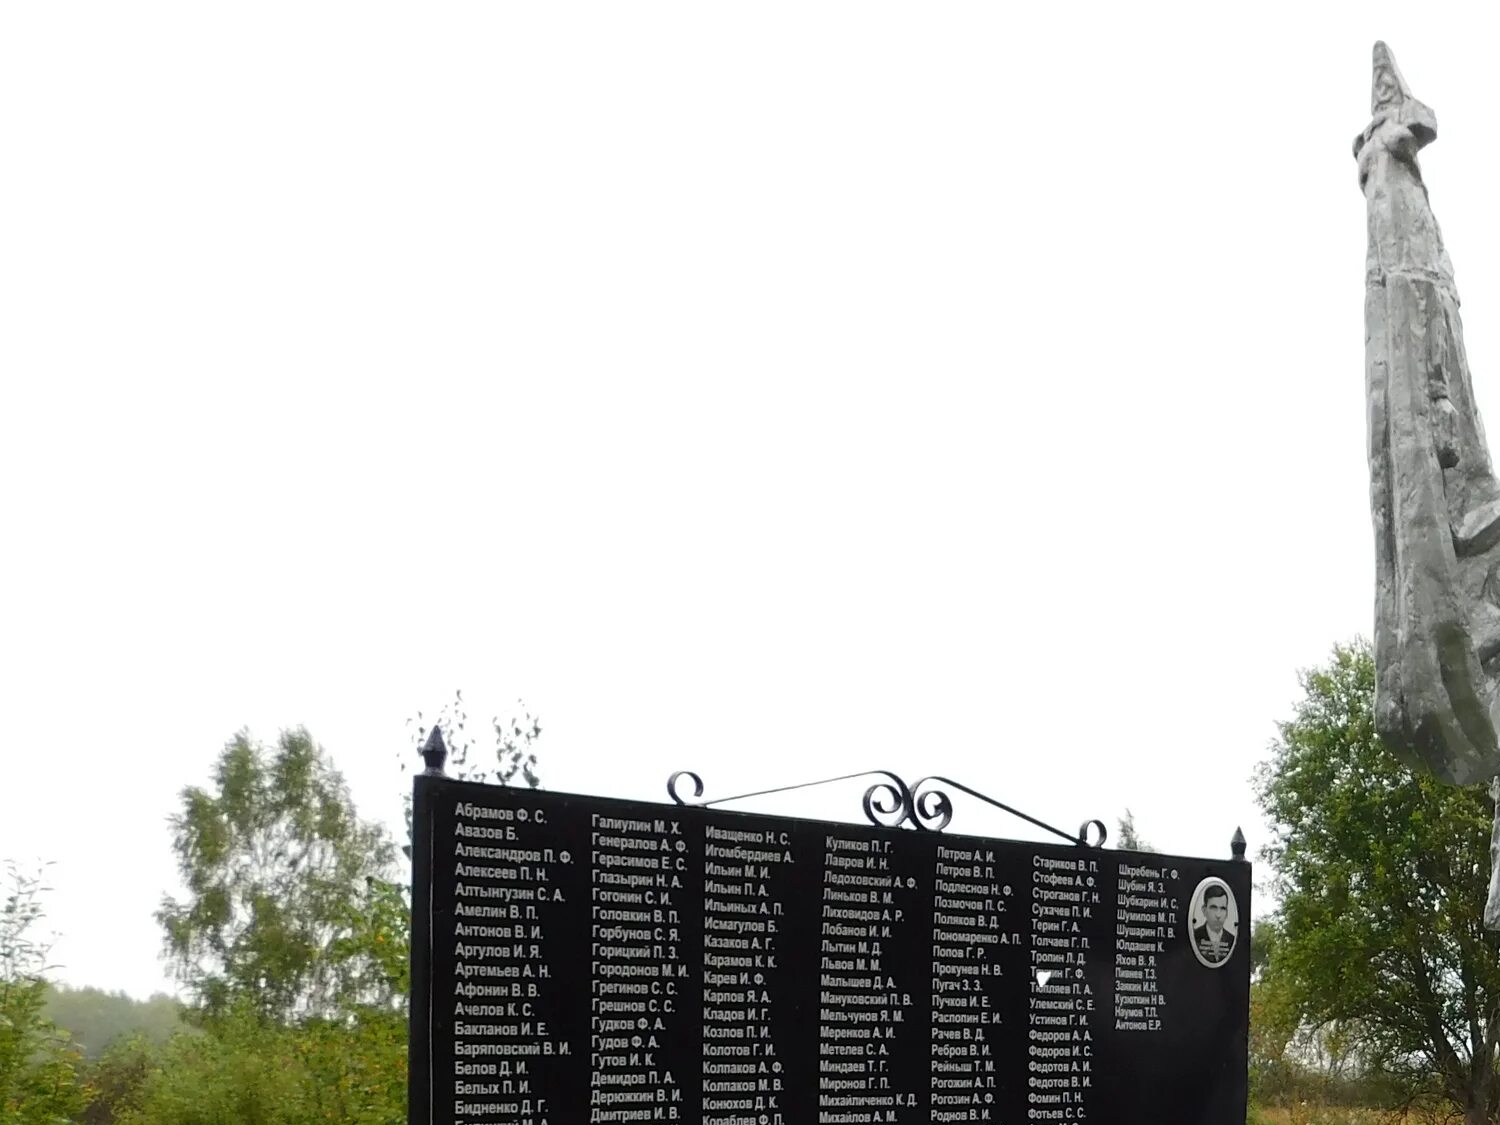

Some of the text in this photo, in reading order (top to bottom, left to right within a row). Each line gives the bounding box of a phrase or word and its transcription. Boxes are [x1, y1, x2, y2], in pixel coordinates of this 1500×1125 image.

[454, 802, 547, 823] Абрамов Ф. С.
[454, 822, 518, 840] Авазов Б.
[591, 813, 681, 834] Галиулин М. Х.
[592, 832, 657, 851] Генералов
[705, 825, 763, 843] Иващенко
[825, 835, 869, 851] Куликов
[454, 842, 573, 864] Александров П. Ф.
[592, 850, 658, 868] Герасимов
[937, 846, 972, 862] Петров
[705, 861, 741, 876] Ильин
[824, 853, 864, 869] Лавров
[1032, 855, 1076, 870] Стариков
[454, 862, 549, 881] Алексеев П. Н.
[936, 862, 971, 878] Петров
[592, 869, 653, 888] Глазырин
[823, 870, 891, 887] Ледоховский
[1118, 878, 1146, 893] Шубин
[454, 882, 534, 902] Алтынгузин
[704, 879, 741, 894] Ильин
[935, 879, 989, 894] Подлеснов
[1032, 886, 1080, 901] Строганов
[592, 887, 642, 903] Гогонин
[454, 902, 506, 918] Амелин
[704, 898, 757, 913] Ильиных
[1031, 902, 1070, 917] Сухачев
[592, 905, 650, 922] Головкин
[933, 911, 976, 926] Поляков
[454, 922, 543, 939] Антонов В. И.
[704, 916, 764, 934] Исмагулов
[821, 922, 866, 936] Лобанов
[1031, 918, 1059, 933] Терин
[592, 924, 651, 942] Горбунов
[933, 928, 998, 945] Пономаренко
[1030, 934, 1069, 947] Толчаев
[704, 934, 748, 949] Казаков
[1116, 938, 1156, 952] Юлдашев
[454, 941, 510, 960] Аргулов
[592, 942, 650, 959] Горицкий
[932, 945, 964, 958] Попов
[1030, 950, 1064, 964] Тропин
[704, 952, 752, 968] Карамов
[820, 956, 854, 970] Львов
[1115, 953, 1136, 965] Яхов
[454, 961, 519, 979] Артемьев
[703, 970, 737, 987] Карев
[932, 977, 960, 993] Пугач
[454, 981, 508, 999] Афонин
[703, 988, 744, 1004] Карпов
[591, 997, 645, 1014] Грешнов
[931, 994, 967, 1009] Пучков
[1029, 997, 1073, 1010] Улемский
[703, 1007, 745, 1022] Кладов
[931, 1010, 978, 1023] Распопин
[1029, 1013, 1067, 1025] Устинов
[454, 1021, 517, 1035] Бакланов
[591, 1016, 634, 1033] Гудков
[703, 1025, 743, 1038] Козлов
[1115, 1018, 1147, 1030] Антонов
[931, 1027, 961, 1039] Рачев
[1028, 1029, 1070, 1043] Федоров
[591, 1034, 628, 1051] Гудов
[702, 1043, 750, 1055] Колотов
[819, 1042, 863, 1055] Метелев
[931, 1043, 967, 1058] Ребров
[1028, 1045, 1070, 1059] Федоров
[454, 1060, 496, 1074] Белов
[591, 1053, 626, 1069] Гутов
[702, 1061, 756, 1073] Колпаков
[1028, 1060, 1069, 1073] Федотов
[590, 1071, 646, 1087] Демидов
[702, 1079, 756, 1092] Колпаков
[819, 1077, 865, 1092] Миронов
[931, 1076, 972, 1088] Рогожин
[1028, 1076, 1069, 1089] Федотов
[455, 1080, 499, 1094] Белых
[590, 1089, 653, 1105] Дерюжкин
[702, 1097, 752, 1110] Конюхов
[819, 1094, 894, 1106] Михайличенко
[931, 1093, 970, 1104] Рогозин
[1028, 1092, 1060, 1103] Фомин
[454, 1100, 518, 1116] Бидненко
[590, 1108, 651, 1123] Дмитриев
[930, 1109, 967, 1122] Роднов
[1027, 1108, 1063, 1119] Фотьев
[819, 1111, 871, 1123] Михайлов
